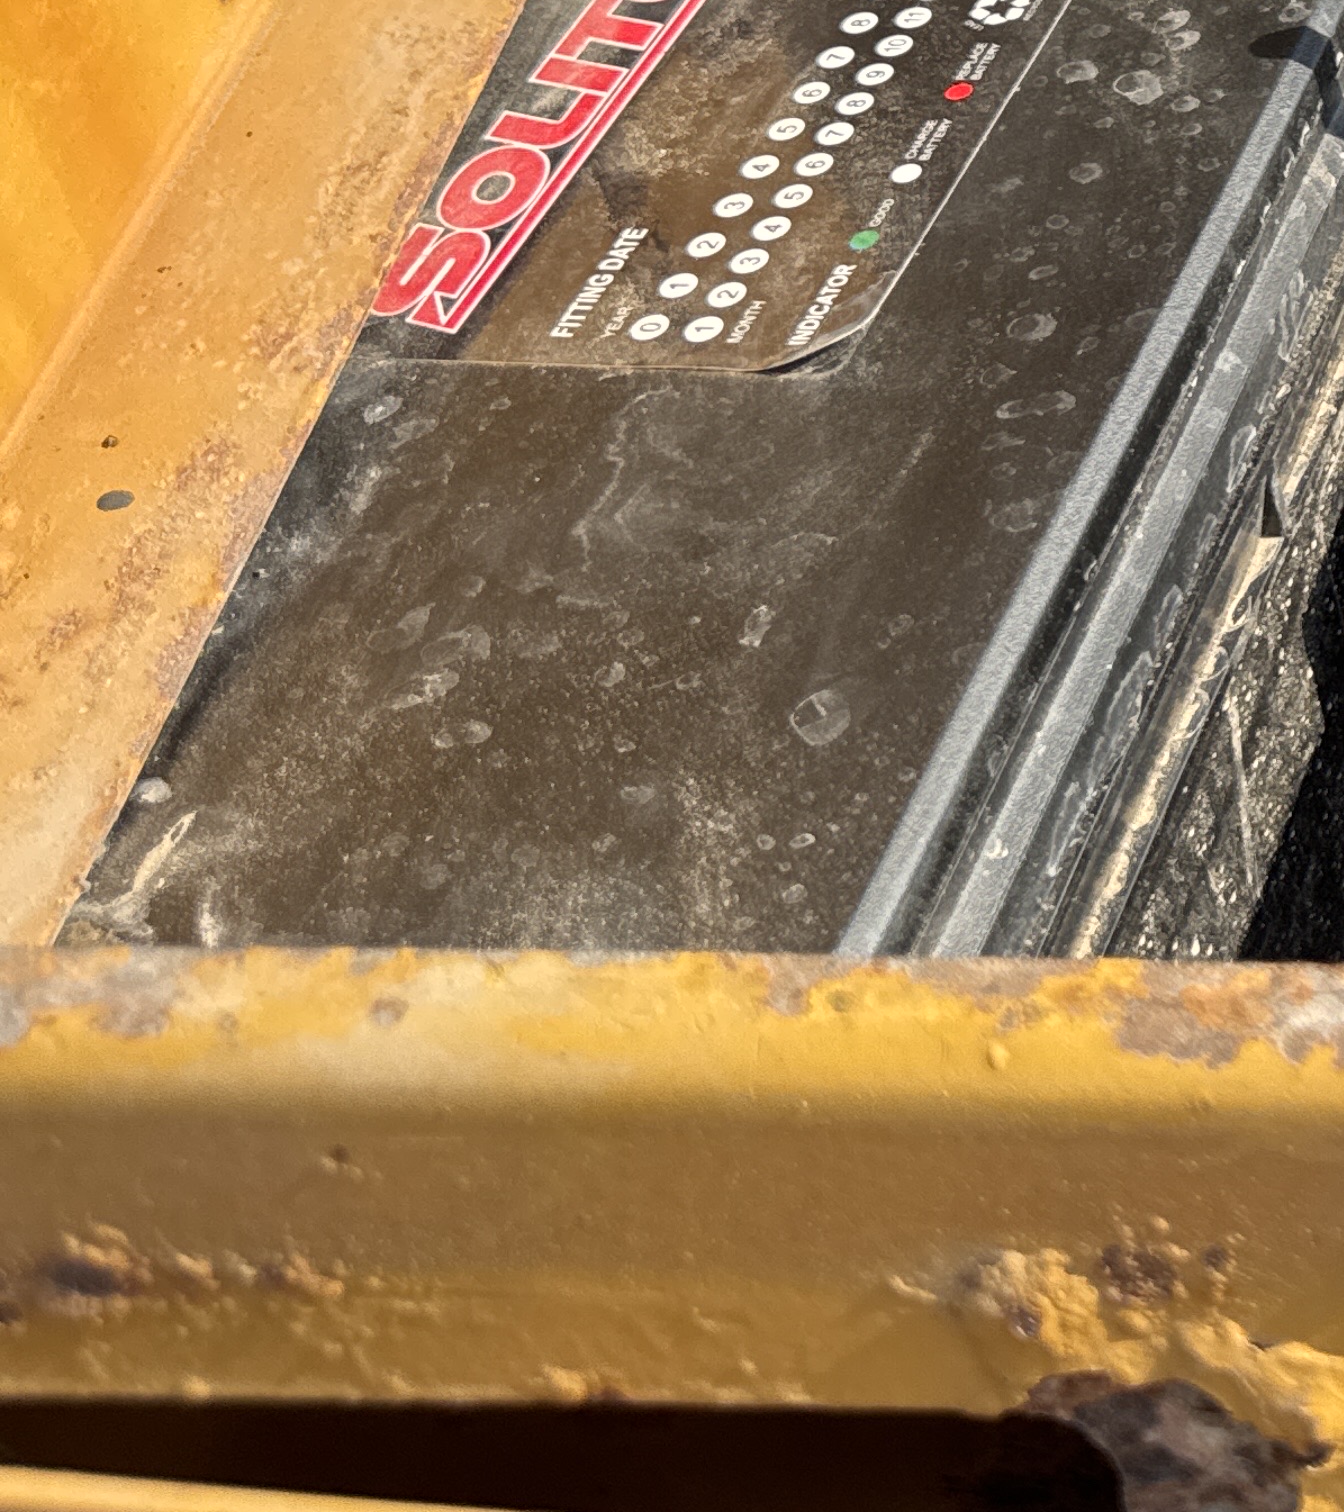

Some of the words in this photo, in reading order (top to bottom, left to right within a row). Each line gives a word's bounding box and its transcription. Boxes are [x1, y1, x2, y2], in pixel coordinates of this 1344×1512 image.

[955, 41, 990, 81] REPLACE
[970, 42, 1001, 81] BATTERY
[903, 118, 939, 160] CHARGE
[918, 117, 953, 162] BATTERY
[868, 198, 895, 227] GOOD
[549, 273, 615, 339] FITTING
[596, 224, 650, 271] DATE
[598, 305, 636, 340] YEAR
[725, 299, 768, 345] MONTH
[786, 263, 858, 346] INDICATOR
